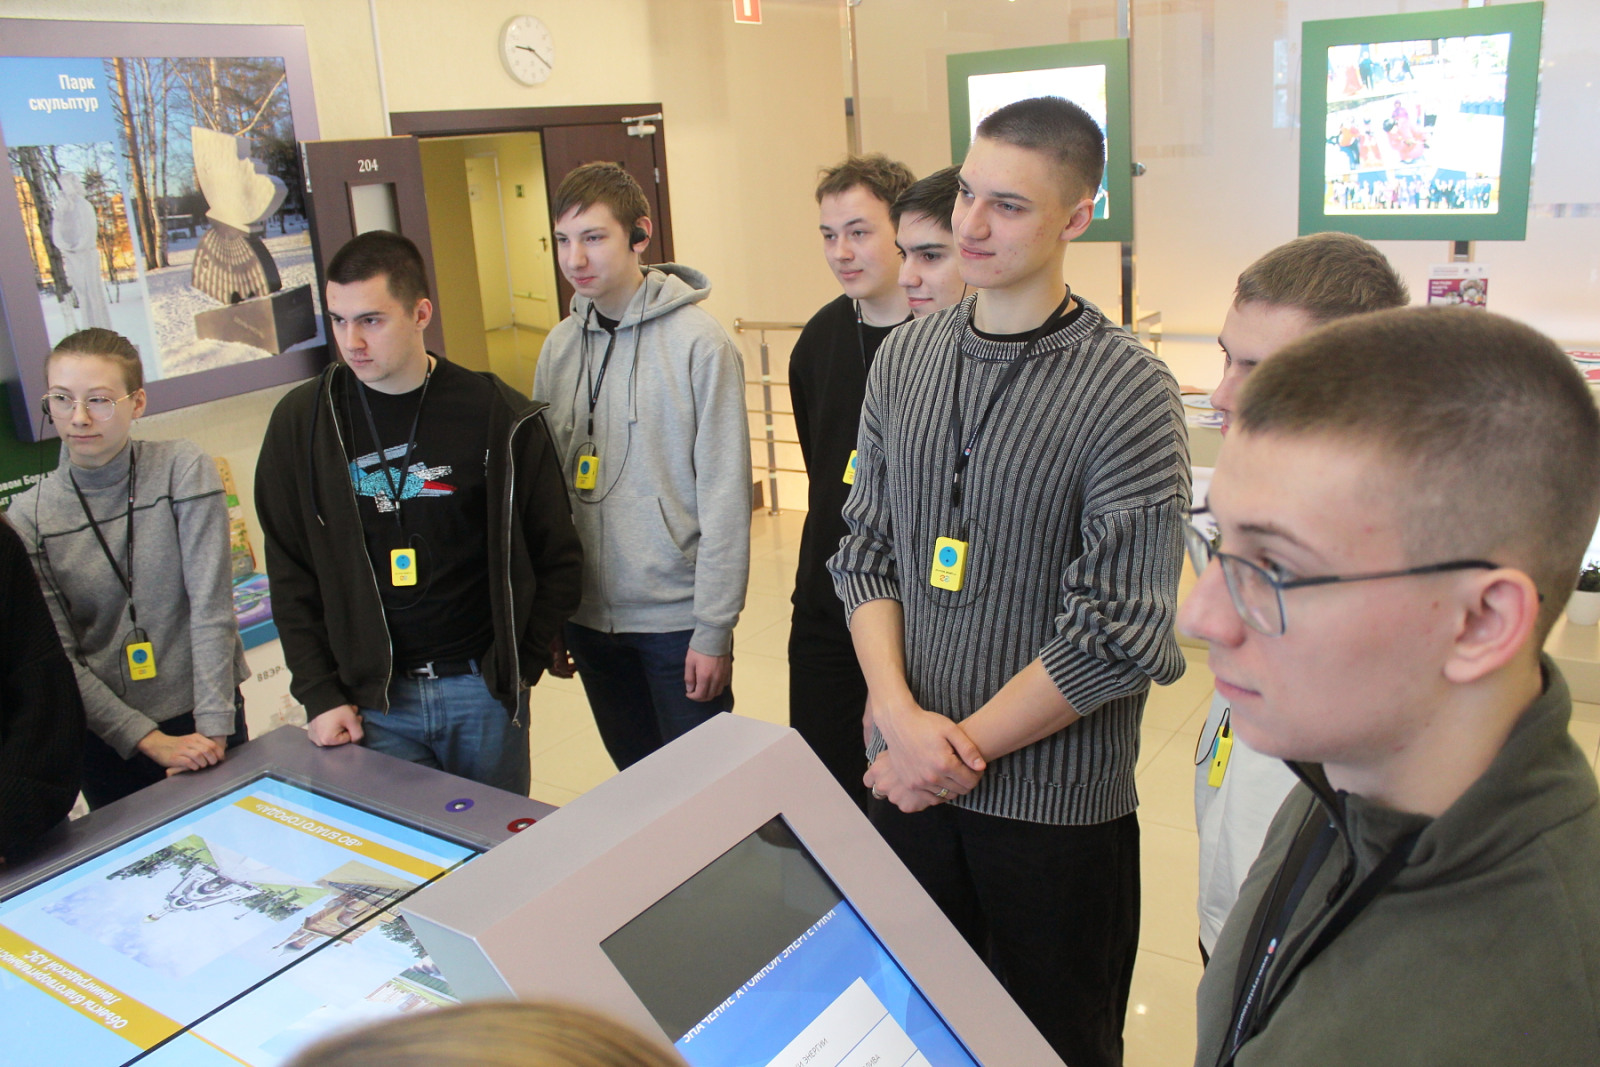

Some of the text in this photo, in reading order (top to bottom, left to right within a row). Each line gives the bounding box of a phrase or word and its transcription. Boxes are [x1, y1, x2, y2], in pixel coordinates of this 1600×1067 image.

[58, 74, 96, 92] Парк
[28, 97, 99, 114] скульптур
[357, 158, 379, 172] 204
[257, 665, 285, 682] ВВЭР-
[301, 821, 342, 840] БЛАГО
[23, 949, 122, 1006] Ленинградской АЭС
[80, 999, 129, 1029] Объекты
[801, 1037, 829, 1065] ЭНЕРГИИ
